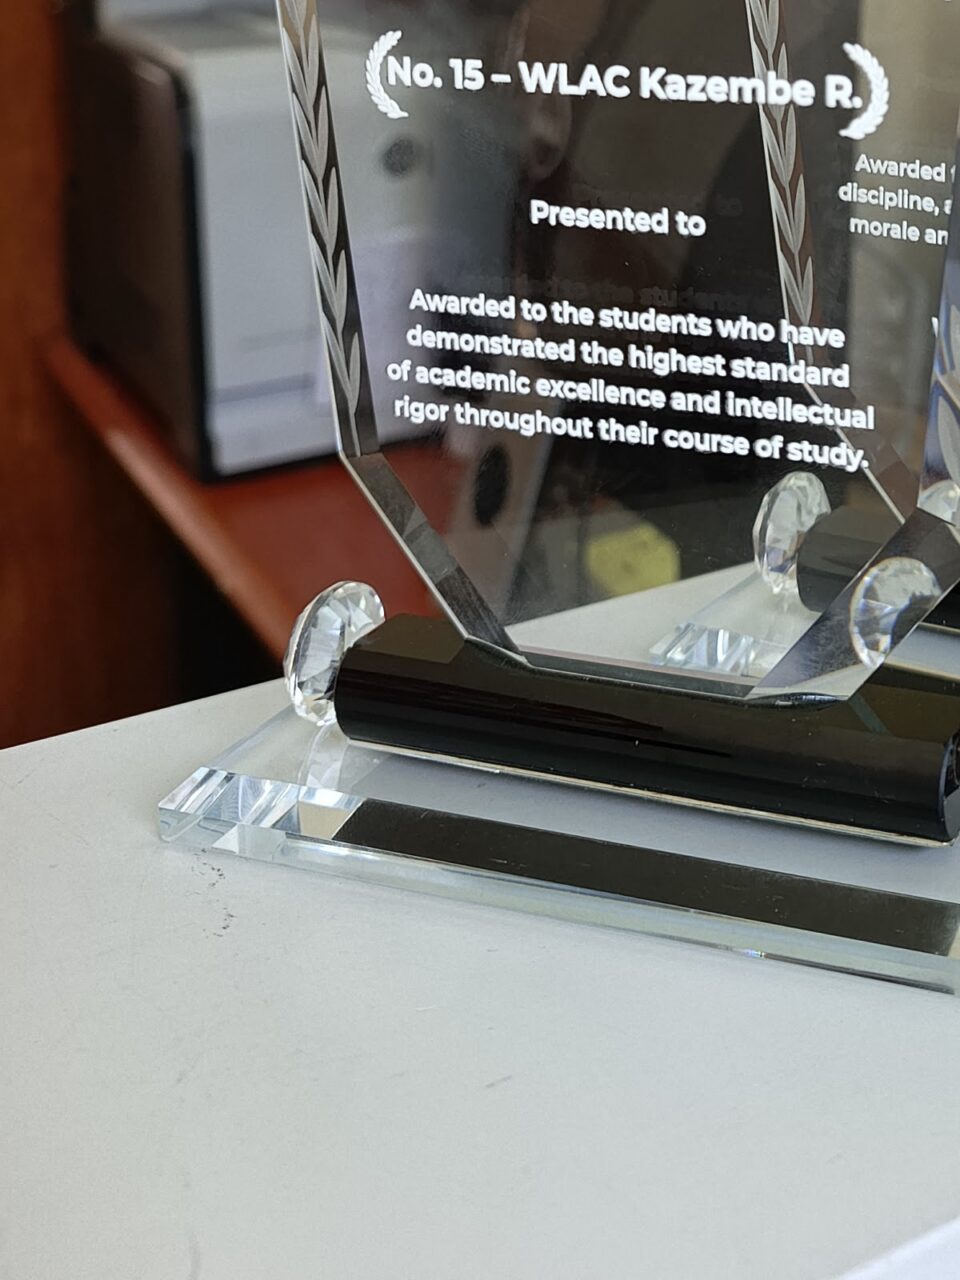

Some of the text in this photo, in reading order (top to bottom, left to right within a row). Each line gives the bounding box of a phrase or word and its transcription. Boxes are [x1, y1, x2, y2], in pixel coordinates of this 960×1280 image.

[386, 56, 443, 89] No.
[448, 58, 485, 91] 15
[518, 61, 630, 98] WLAC
[639, 67, 816, 108] Kazembe
[825, 74, 864, 110] R.
[855, 154, 946, 183] Awarded
[530, 200, 707, 237] Presented to
[838, 183, 940, 216] discipline,
[849, 215, 920, 243] morale
[409, 289, 516, 321] Awarded
[520, 296, 547, 322] to
[551, 299, 594, 328] the
[598, 302, 712, 337] students
[716, 310, 776, 343] who
[780, 318, 846, 349] have
[406, 324, 850, 389] demonstrated the highest standard
[386, 360, 875, 431] of academic excellence and intellectual
[393, 396, 870, 474] rigor throughout their course of study.
